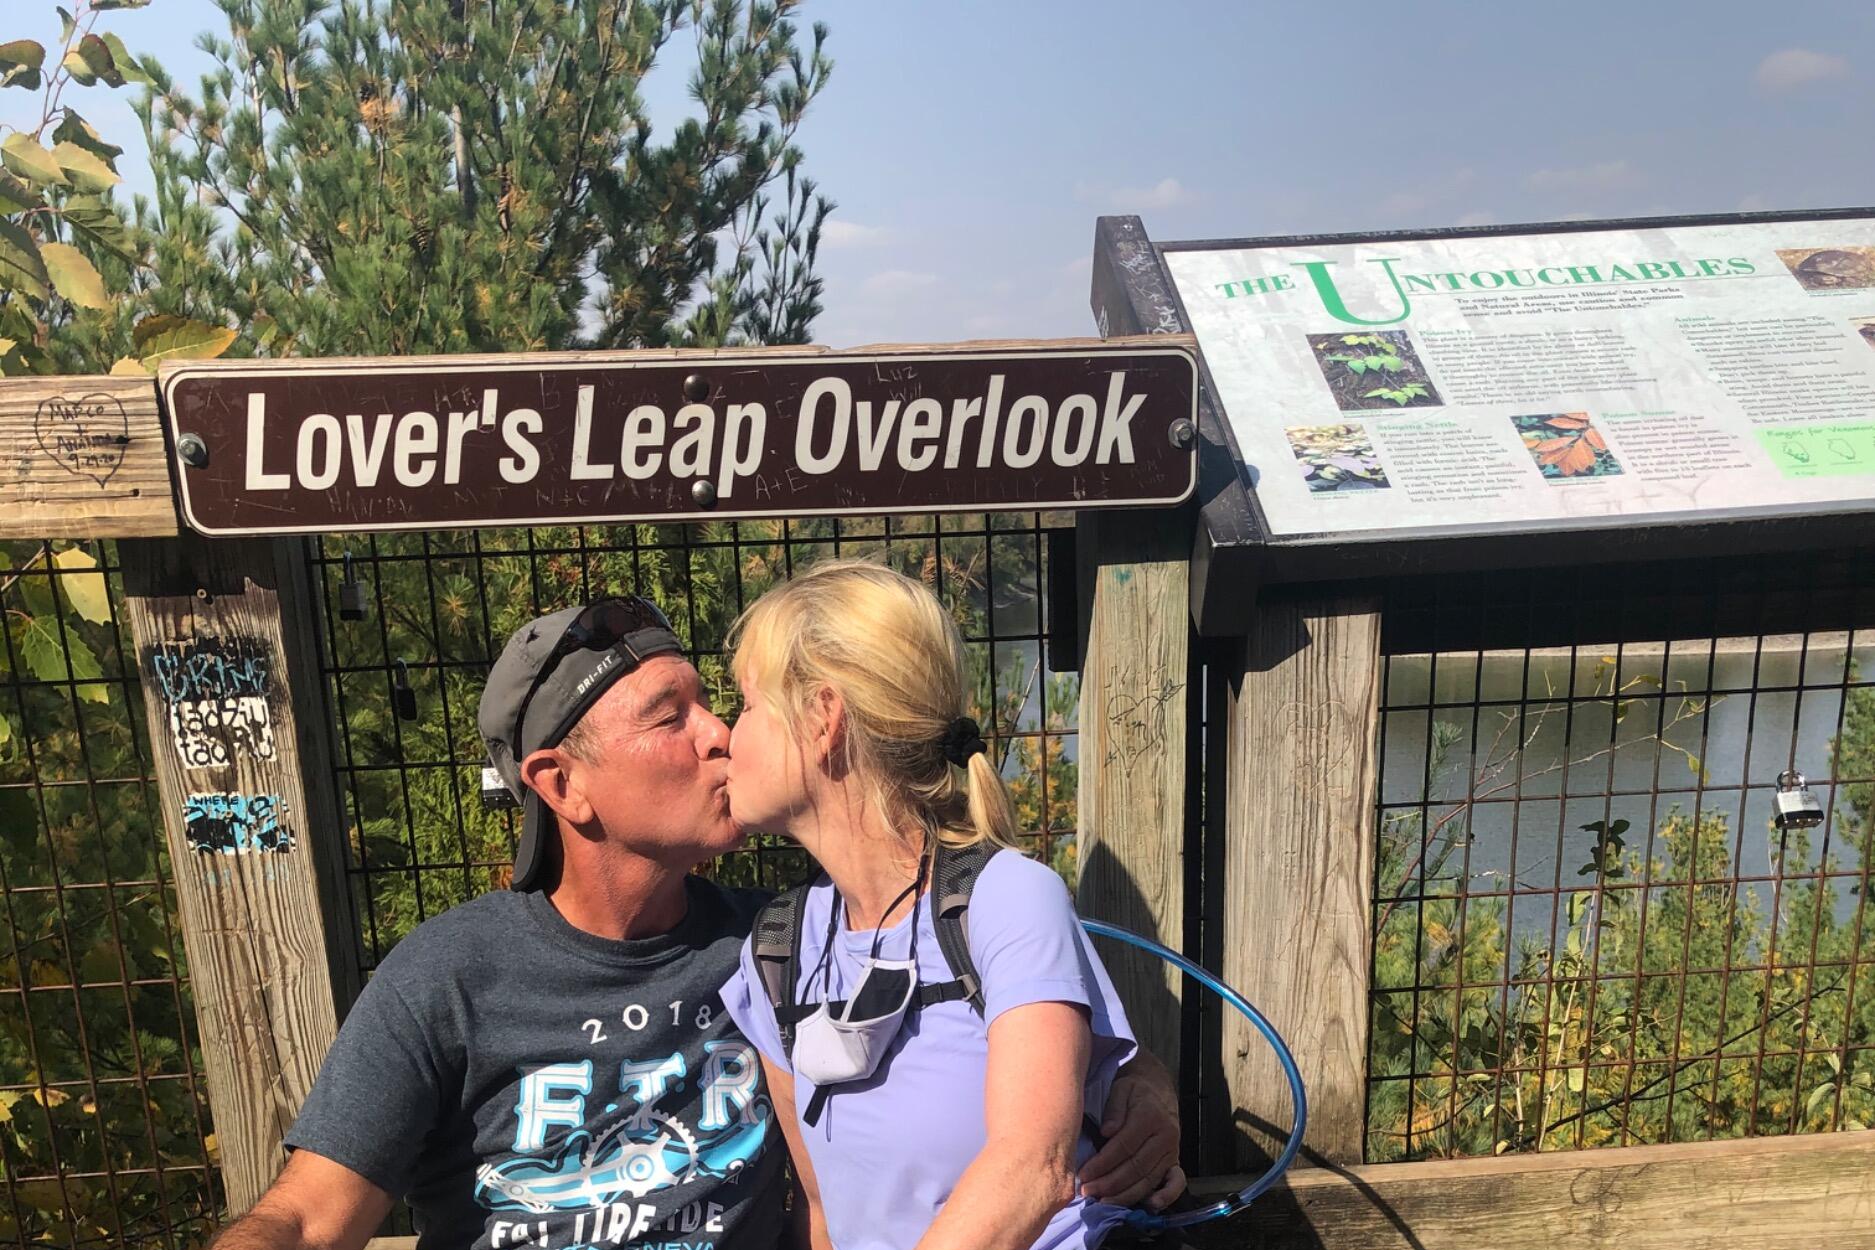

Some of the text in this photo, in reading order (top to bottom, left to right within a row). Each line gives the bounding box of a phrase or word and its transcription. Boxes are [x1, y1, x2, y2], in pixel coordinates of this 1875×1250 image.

[1215, 257, 1756, 326] THE UNTOUCHABLES
[245, 372, 1148, 499] Lover's Leap Overlook
[577, 655, 613, 694] DRI-FIT
